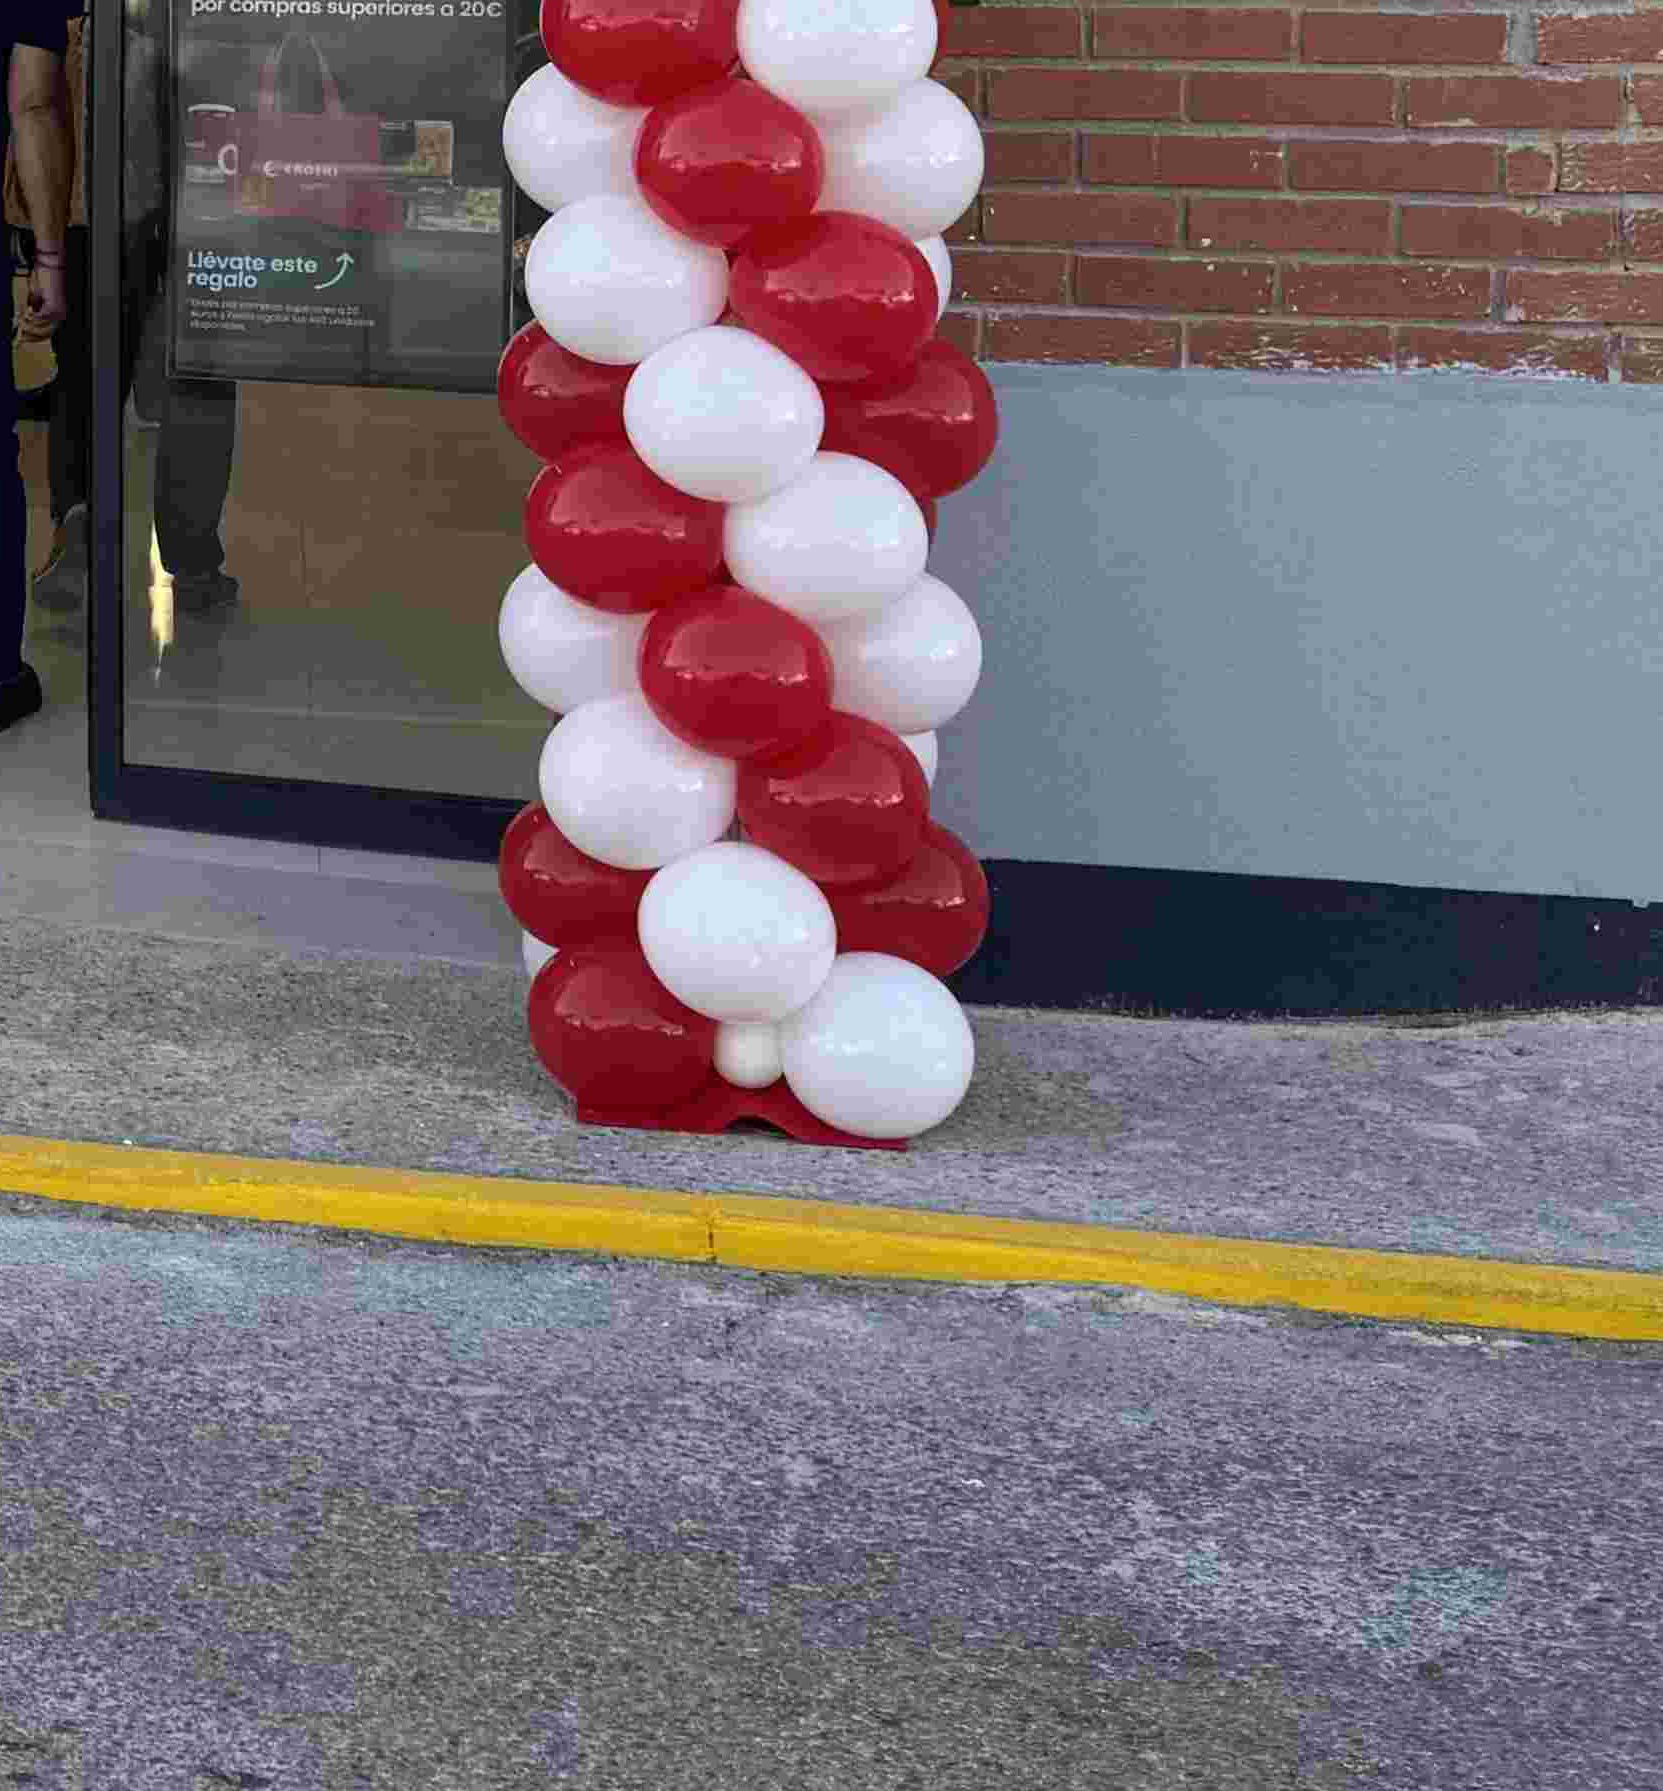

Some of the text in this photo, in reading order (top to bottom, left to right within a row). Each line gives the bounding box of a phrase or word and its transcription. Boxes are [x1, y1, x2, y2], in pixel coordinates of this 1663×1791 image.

[229, 0, 323, 18] compras
[440, 1, 455, 17] a
[460, 1, 503, 18] 20€
[186, 250, 318, 273] Llévate este
[186, 270, 258, 292] regalo
